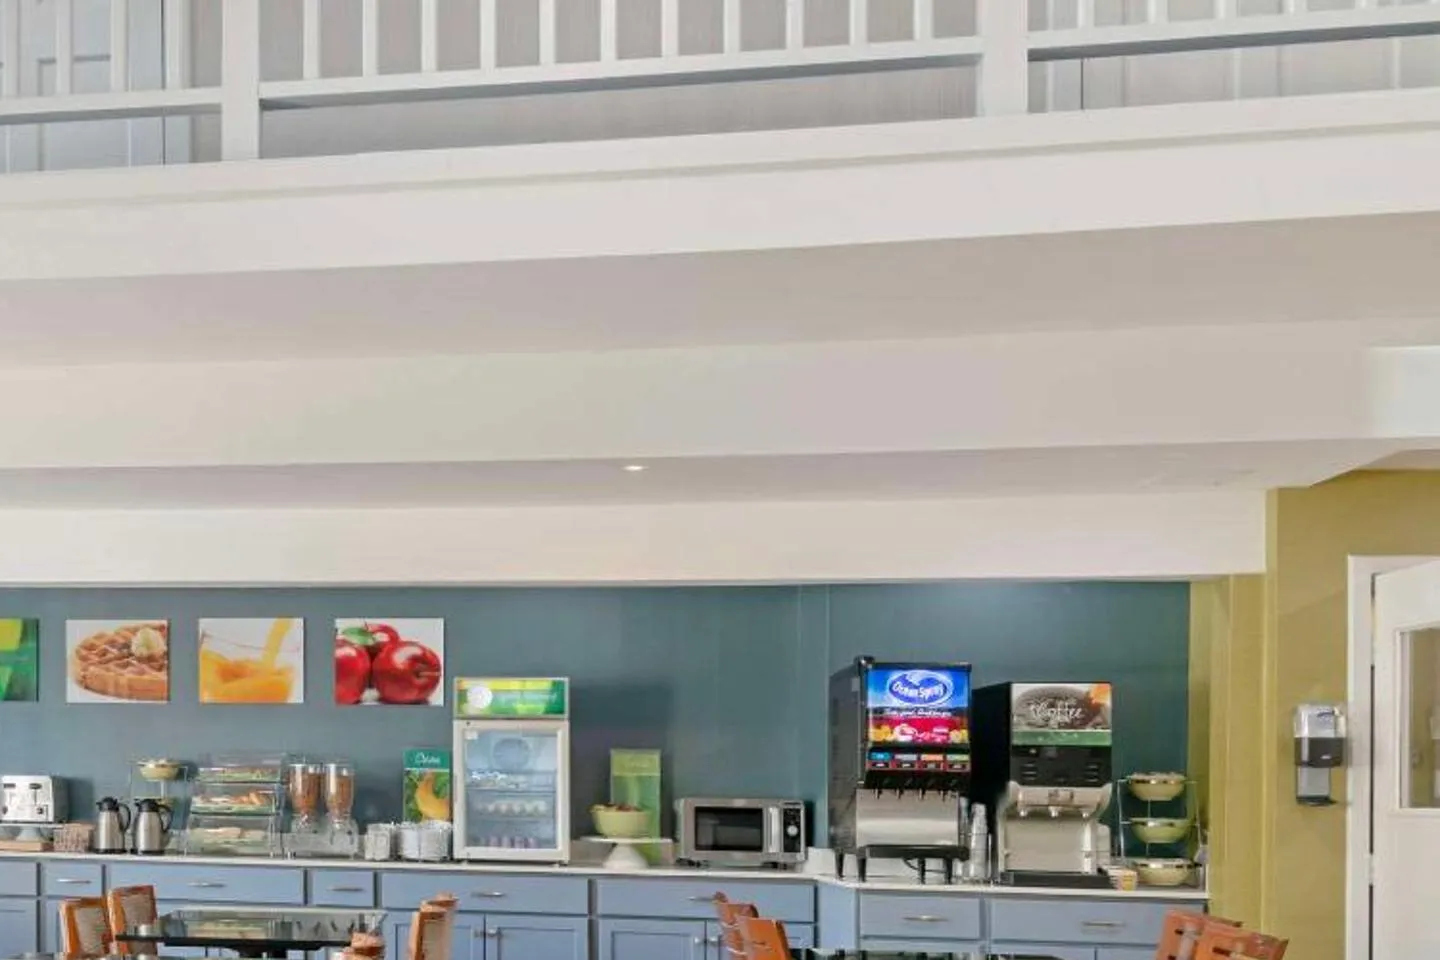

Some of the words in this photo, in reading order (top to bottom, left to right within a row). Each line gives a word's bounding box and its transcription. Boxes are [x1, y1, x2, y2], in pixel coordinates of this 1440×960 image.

[892, 681, 919, 698] Ocean
[919, 682, 947, 701] Spray
[1031, 701, 1083, 722] Coffee
